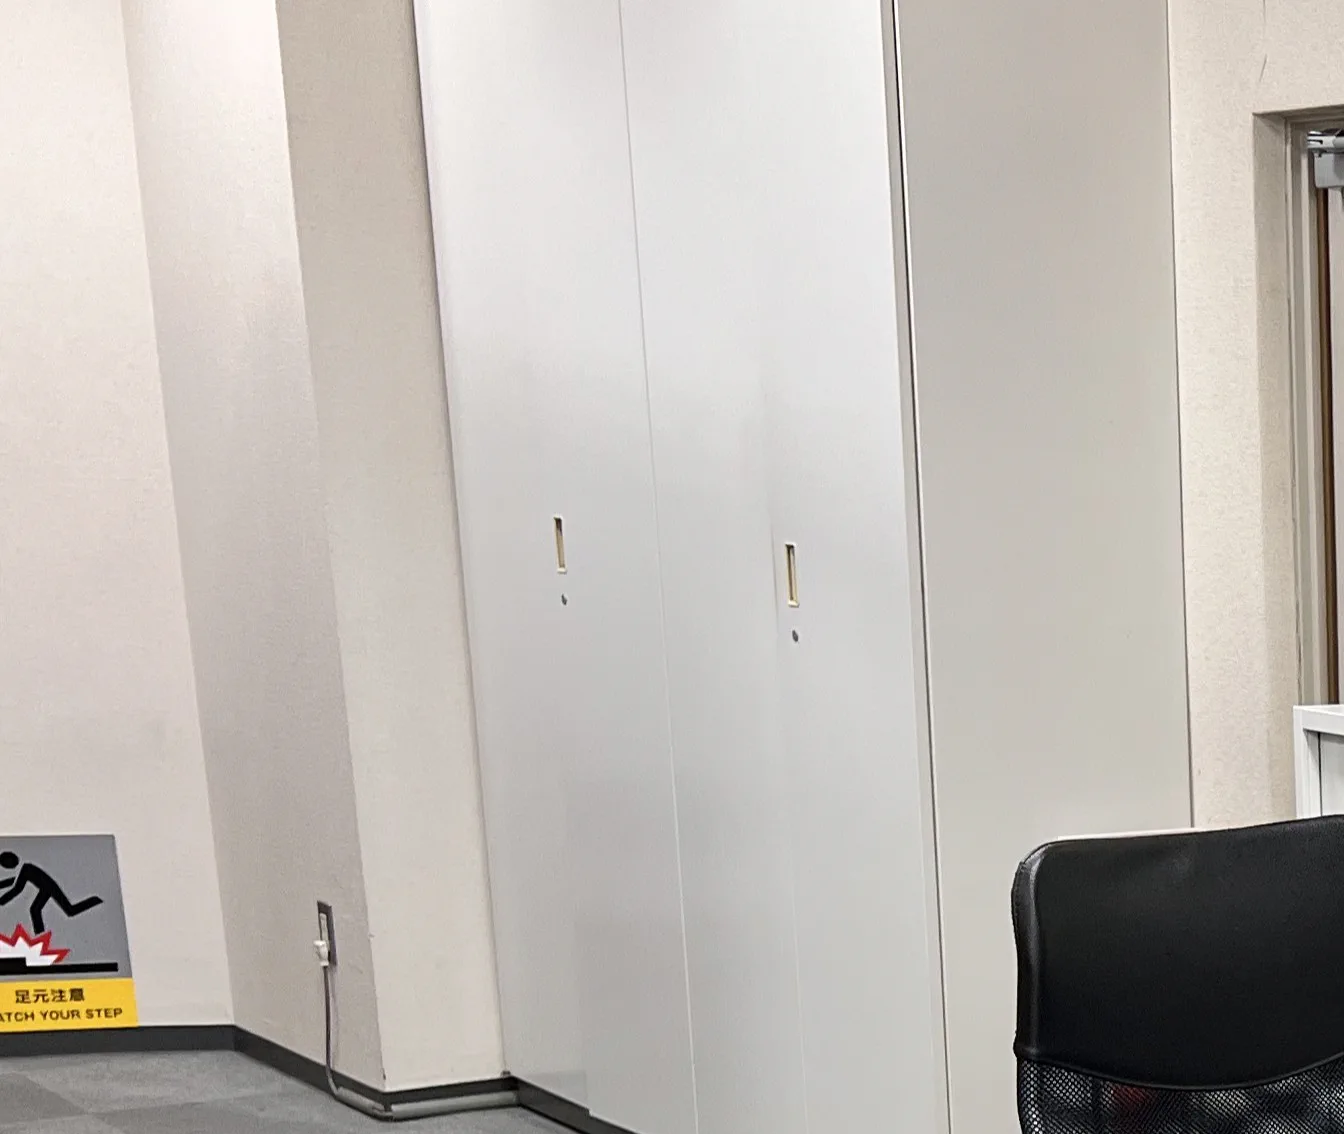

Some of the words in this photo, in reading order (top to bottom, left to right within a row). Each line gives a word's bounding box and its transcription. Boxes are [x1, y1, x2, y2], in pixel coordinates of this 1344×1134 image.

[15, 988, 86, 1004] 足元注意
[40, 1009, 81, 1021] YOUR
[86, 1007, 123, 1019] STEP
